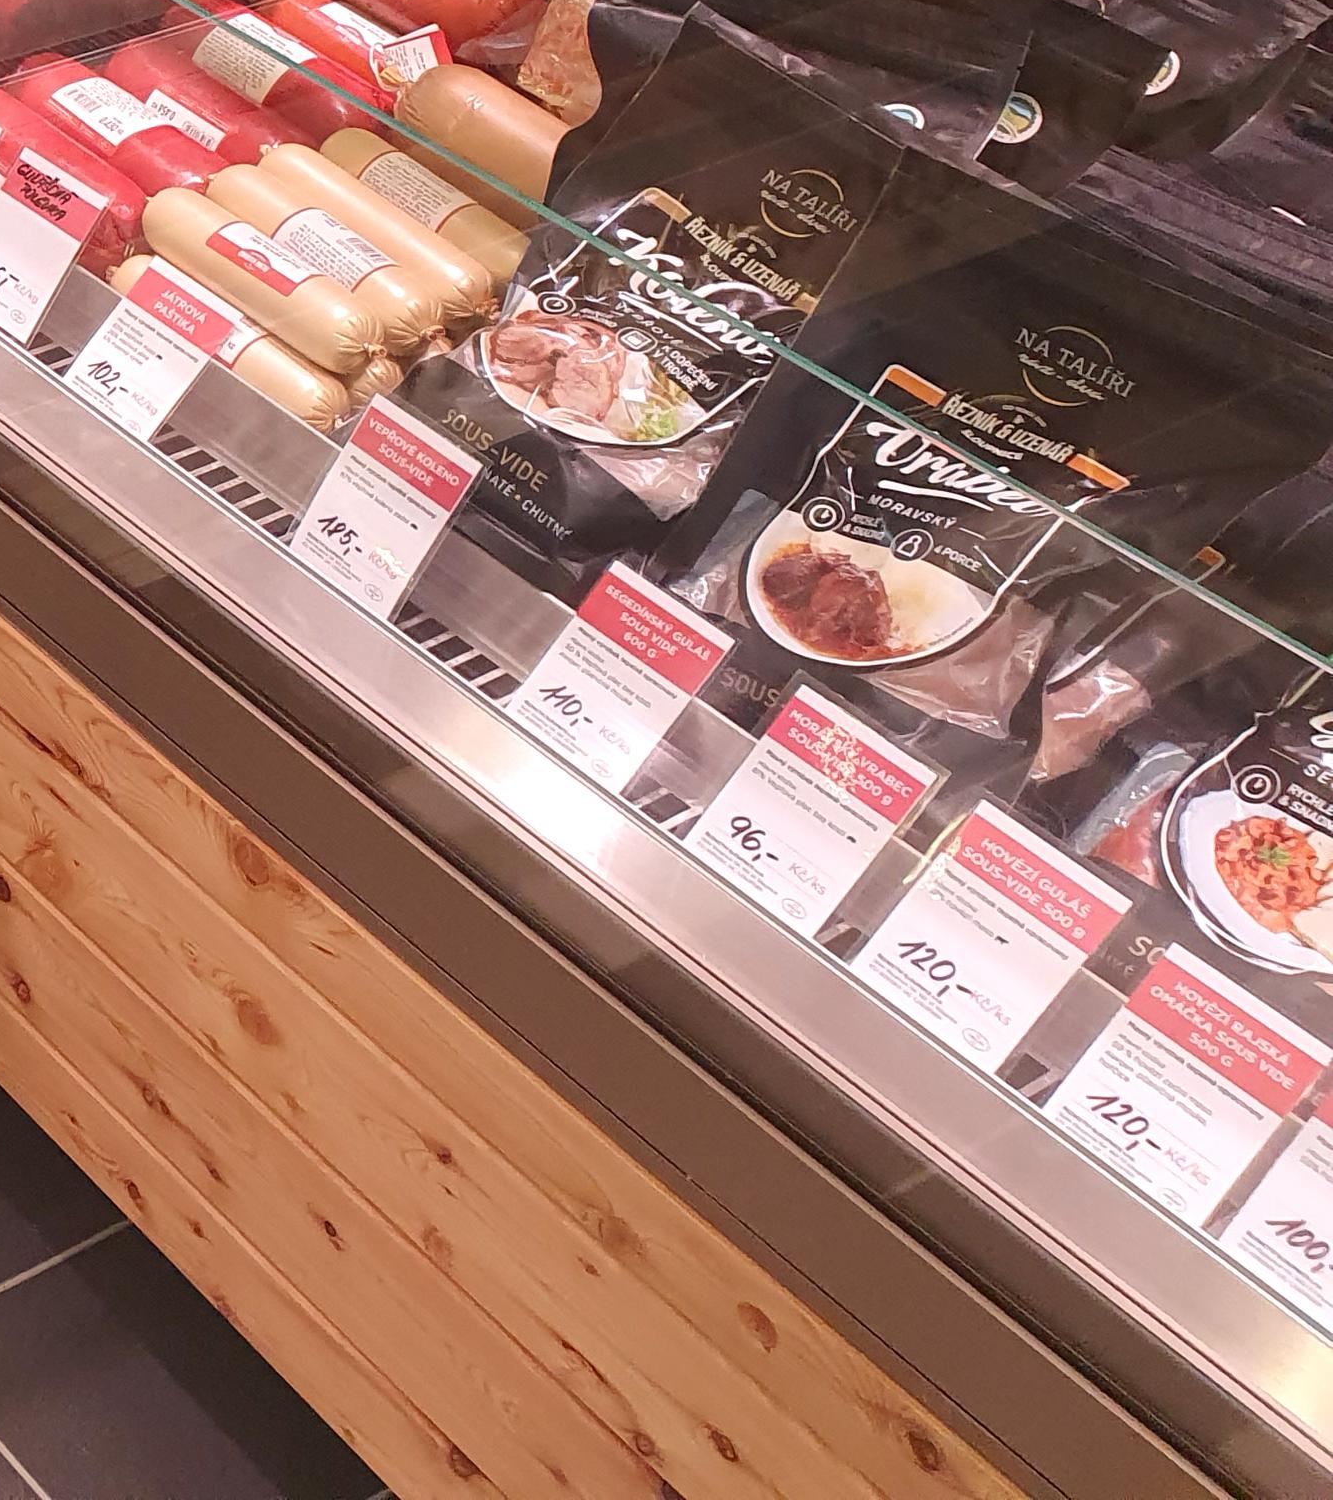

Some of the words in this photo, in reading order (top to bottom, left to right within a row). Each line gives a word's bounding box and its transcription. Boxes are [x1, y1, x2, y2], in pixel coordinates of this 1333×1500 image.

[761, 169, 792, 194] NA
[793, 186, 857, 232] TALÍŘI
[684, 214, 737, 261] ŘEZNÍK
[730, 251, 748, 268] &
[741, 257, 802, 301] UZENÁŘ
[153, 300, 196, 335] PAŠTIKA
[160, 288, 208, 325] JÁTROVÁ
[87, 360, 129, 396] 102,-
[668, 348, 719, 392] DOPEČENÍ
[1015, 327, 1051, 357] NA
[1054, 347, 1136, 398] TALÍŘI
[442, 409, 548, 492] SOUS-VIDE
[941, 394, 996, 435] ŘEZNÍK
[995, 422, 1009, 440] &
[1008, 427, 1076, 463] UZENÁŘ
[368, 417, 418, 458] VEPŘOVÉ
[414, 450, 461, 487] KOLENO
[377, 442, 434, 487] SOUS-VIDE
[482, 463, 516, 498] NATÉ
[866, 493, 957, 529] MORAVSKÝ
[941, 546, 982, 572] PORCE
[605, 583, 674, 637] SEGEDÍNSKÝ
[672, 629, 712, 662] GULÁŠ
[618, 610, 651, 639] SOUS
[650, 631, 679, 658] VIDE
[622, 631, 648, 653] 600
[647, 647, 659, 661] G
[719, 667, 780, 707] SOUS
[854, 773, 882, 801] 500
[881, 793, 894, 809] g
[859, 755, 914, 799] VRABEC
[1303, 762, 1333, 788] SE
[731, 816, 779, 862] 96,-
[789, 861, 826, 897] Kč/ks
[962, 845, 1042, 906] SOUS-VIDE
[1041, 901, 1073, 930] 500
[1073, 926, 1087, 941] g
[981, 838, 1040, 882] HOVĚZÍ
[1038, 875, 1092, 919] GULÁŠ
[898, 940, 973, 997] 120,-
[970, 989, 1012, 1026] Kč/ks
[1173, 980, 1233, 1026] HOVĚZÍ
[1230, 1018, 1290, 1068] RAJSKÁ
[1149, 984, 1213, 1038] OMÁČKA
[1214, 1028, 1257, 1066] SOUS
[1258, 1057, 1296, 1091] VIDE
[1188, 1030, 1220, 1060] 500
[1220, 1053, 1234, 1068] G
[1085, 1093, 1162, 1152] 120,-
